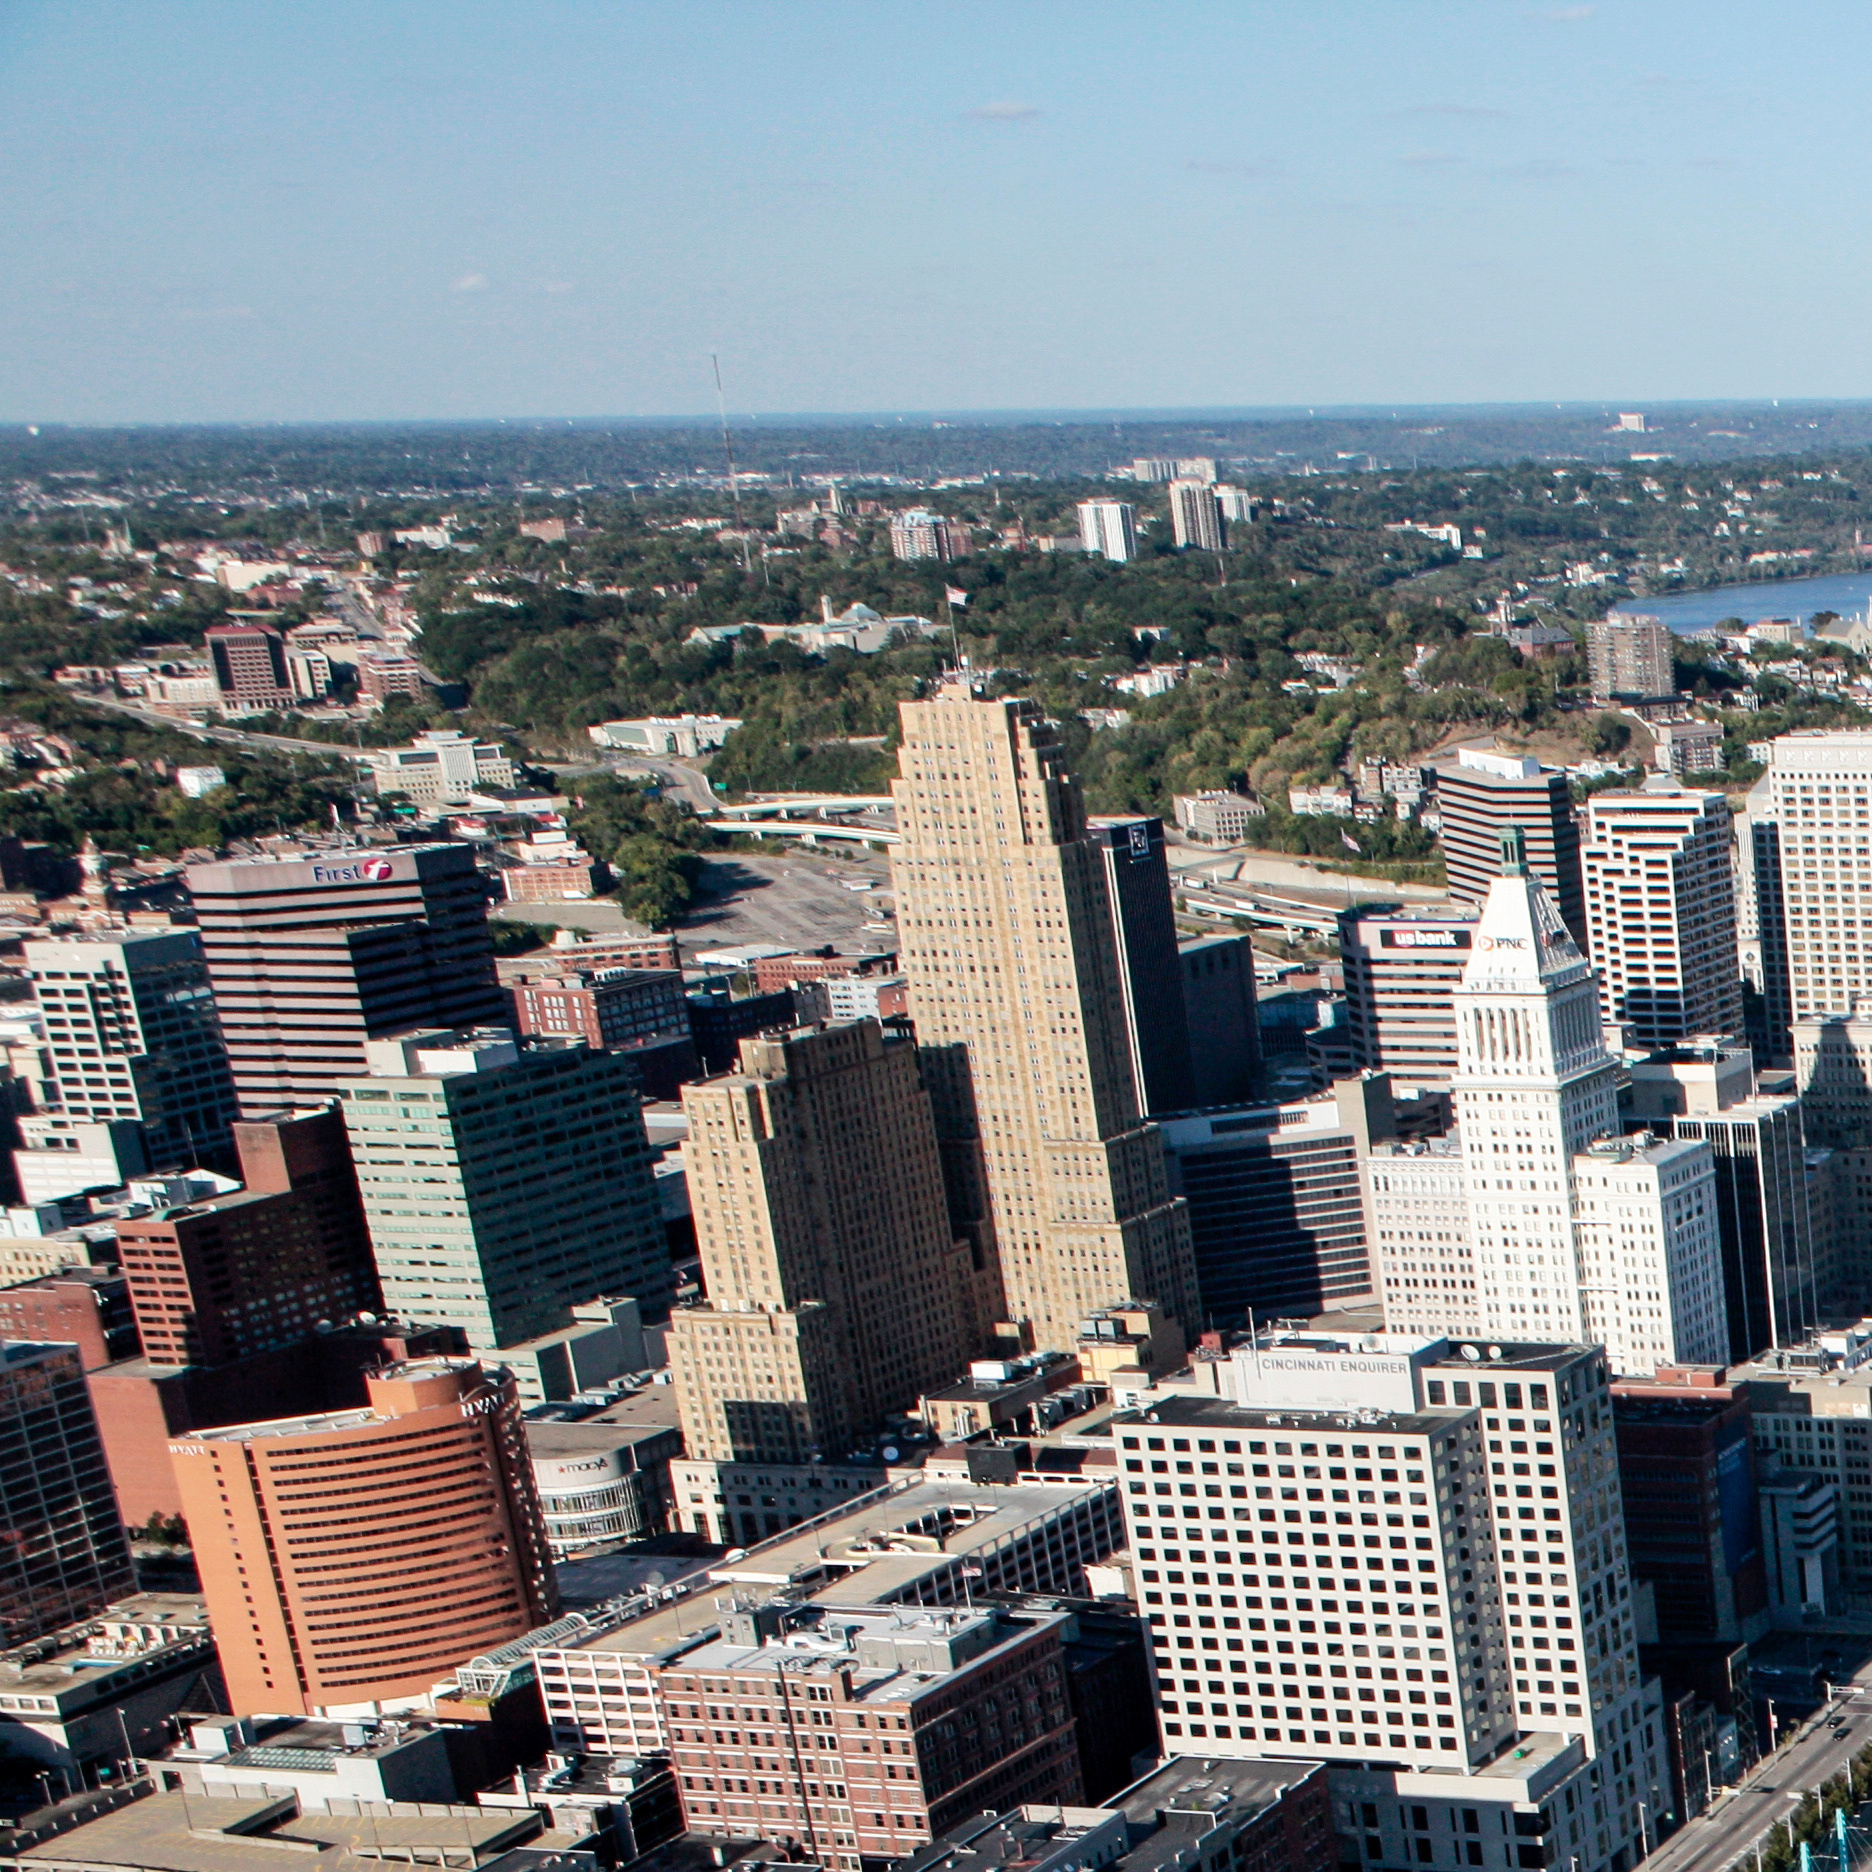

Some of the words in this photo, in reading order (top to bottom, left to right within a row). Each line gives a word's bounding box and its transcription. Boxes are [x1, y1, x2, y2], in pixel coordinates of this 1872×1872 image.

[314, 865, 361, 882] First
[1394, 930, 1457, 946] usbank
[1496, 937, 1528, 950] PNC
[1262, 1358, 1336, 1371] CINCINNATI
[1340, 1361, 1408, 1374] ENQUIRER
[460, 1392, 505, 1418] HYATT
[168, 1445, 206, 1456] HYATT
